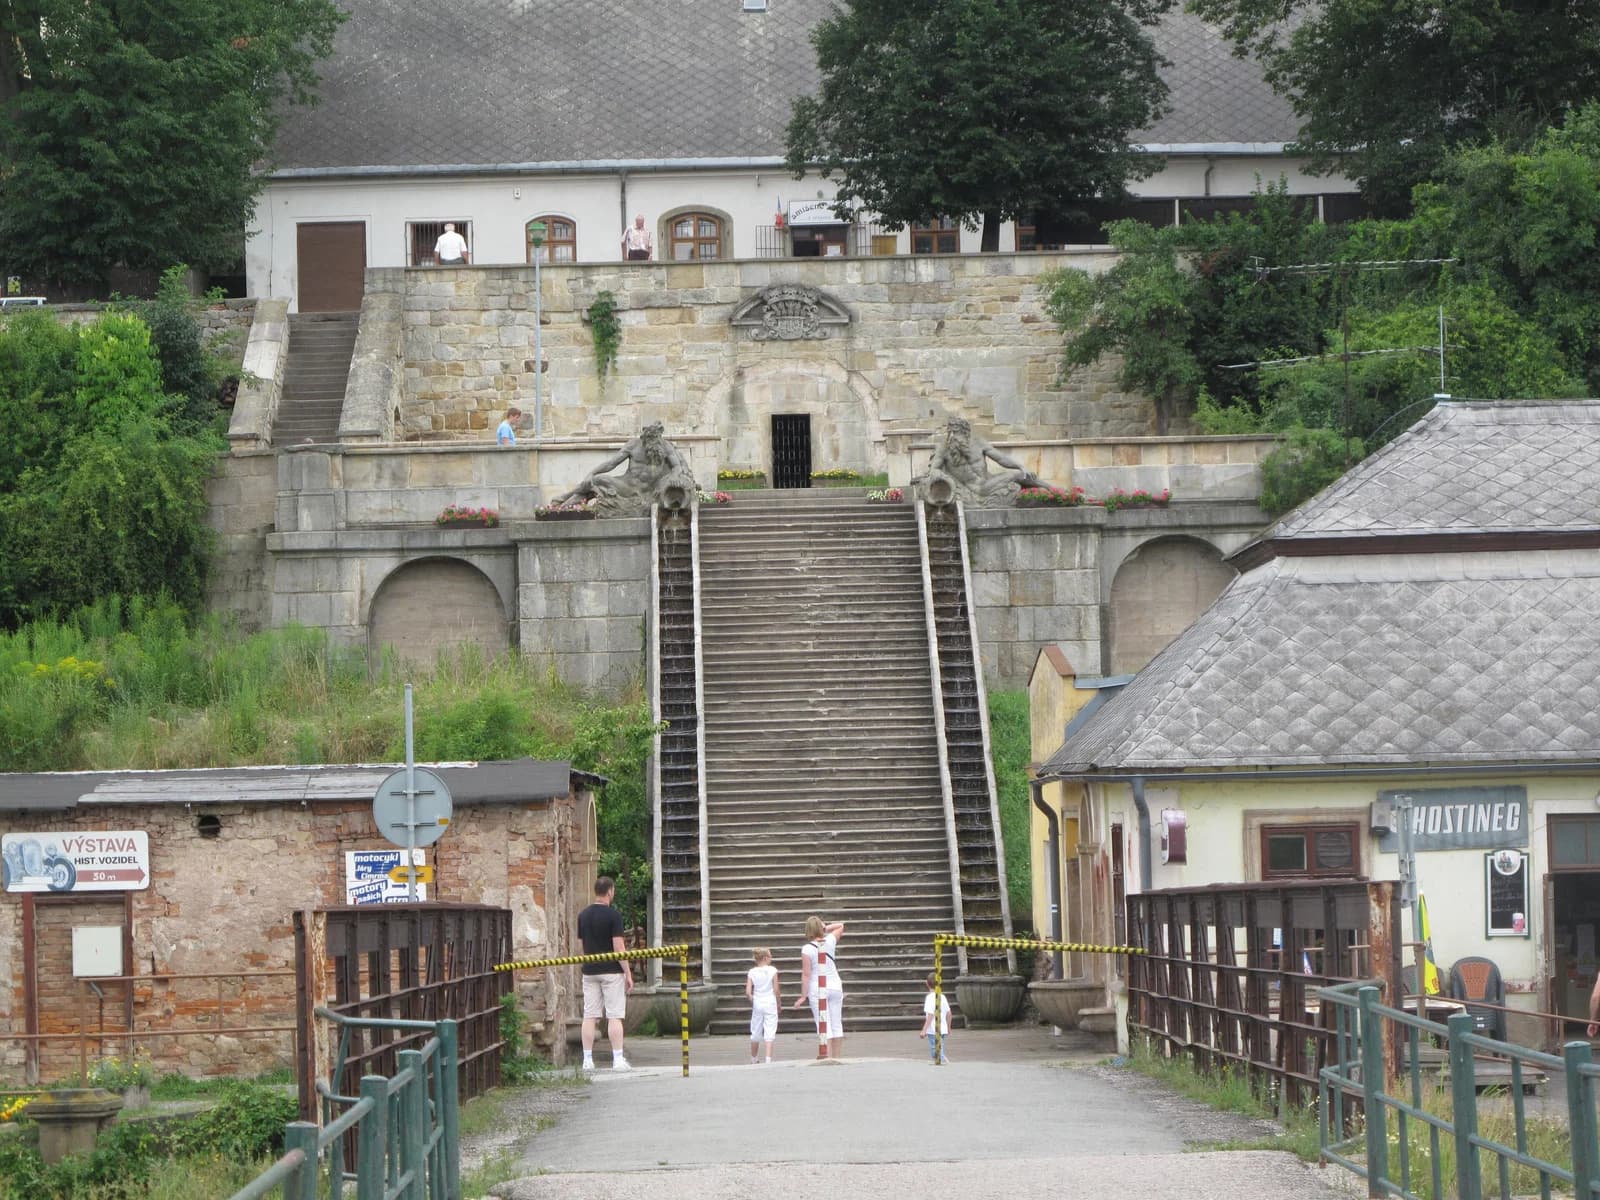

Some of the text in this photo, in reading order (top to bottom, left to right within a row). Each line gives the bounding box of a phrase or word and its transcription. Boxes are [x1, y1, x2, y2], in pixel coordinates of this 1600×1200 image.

[1413, 802, 1521, 834] HOSTINEC
[62, 836, 137, 853] VÝSTAVA
[74, 856, 138, 865] HIST. VOZIDEL
[354, 852, 399, 863] motocykl
[350, 881, 386, 896] motory
